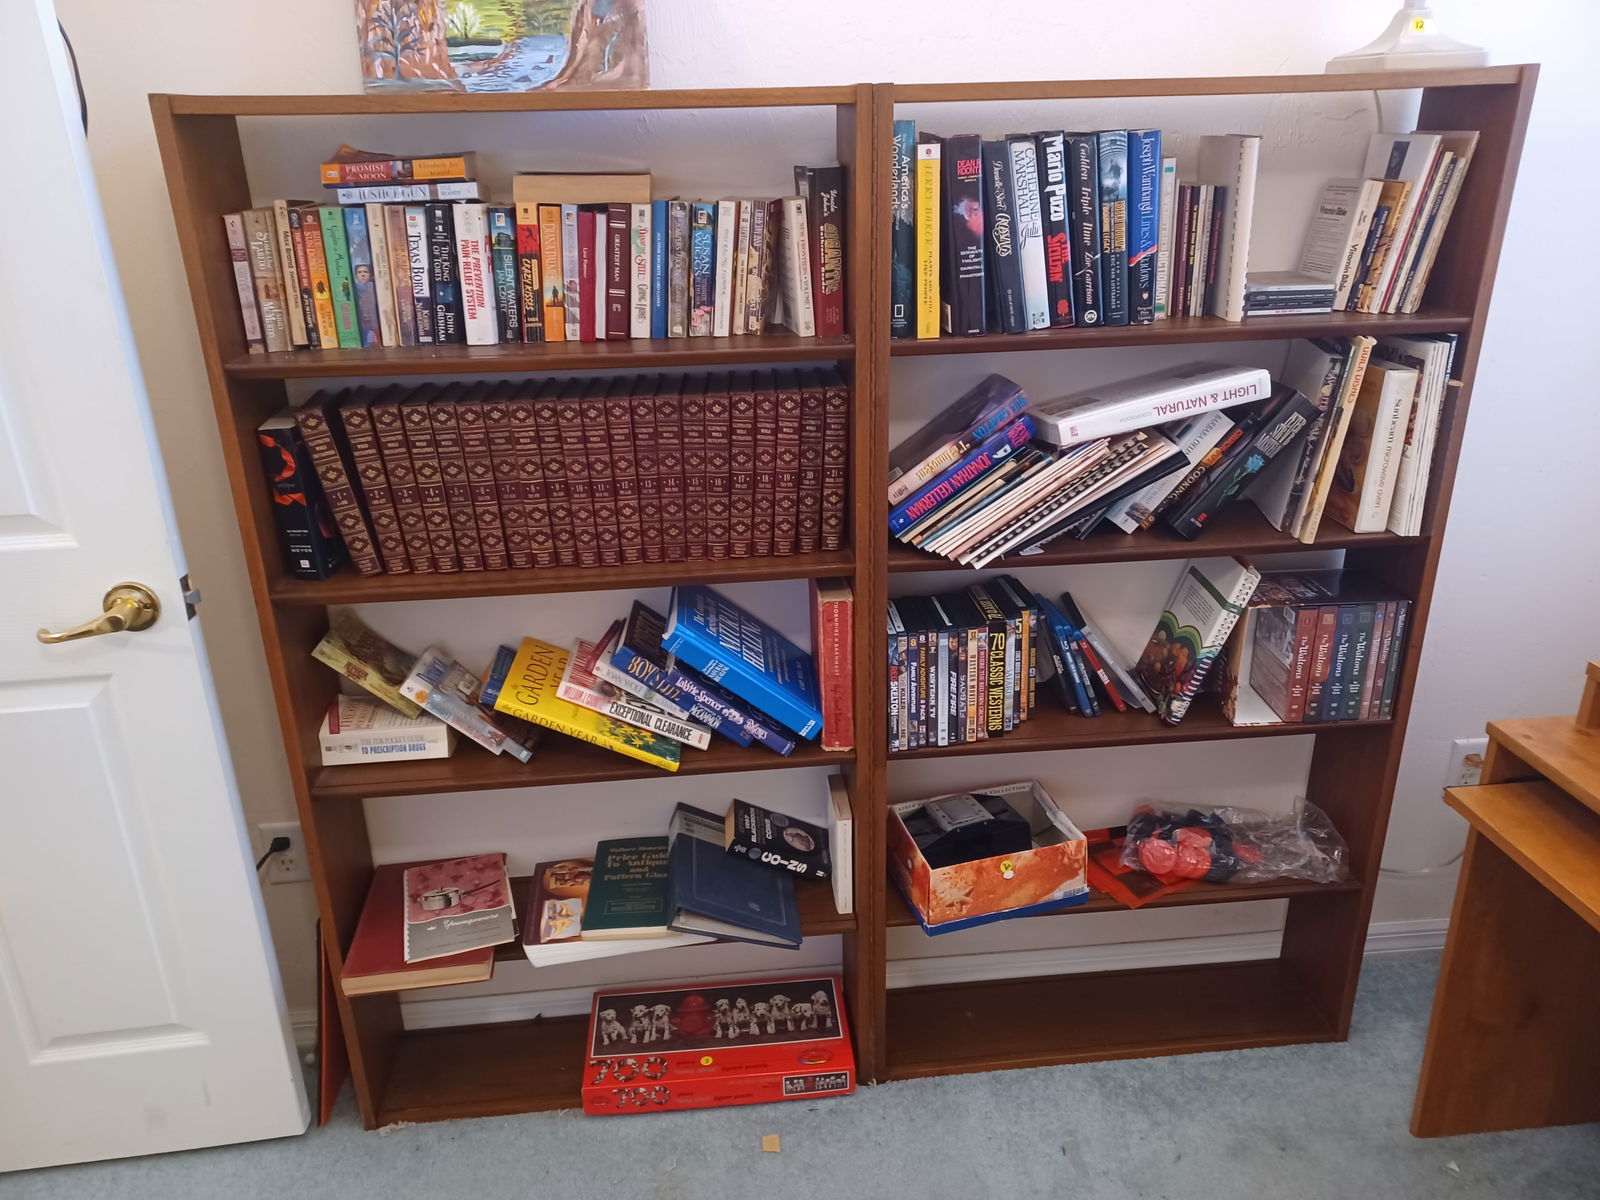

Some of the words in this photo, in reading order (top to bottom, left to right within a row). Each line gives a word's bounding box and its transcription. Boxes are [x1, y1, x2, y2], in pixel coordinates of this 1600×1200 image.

[957, 159, 976, 169] DEAN
[1042, 132, 1066, 183] Mario
[1079, 143, 1090, 179] Golden
[1139, 136, 1154, 165] Joseph
[344, 163, 385, 172] PROMISE
[358, 172, 385, 180] MOON
[891, 134, 901, 209] Wonderlands
[900, 155, 910, 208] America's
[991, 159, 1005, 189] Danielle
[924, 165, 933, 200] JERRY
[1011, 148, 1032, 221] MARSHALL
[1021, 146, 1042, 219] CATHERINE
[1138, 165, 1154, 215] Wambaugh
[819, 192, 830, 216] John's
[828, 189, 837, 212] Uncle
[1043, 183, 1066, 222] Puzo
[1079, 186, 1092, 215] Triple
[282, 230, 290, 245] Max
[542, 223, 555, 248] DIANA
[924, 207, 933, 245] BAKER
[990, 211, 1014, 257] CROSSINGS
[1082, 222, 1094, 245] Time
[1140, 215, 1152, 239] Lines
[284, 246, 294, 268] Brand
[407, 231, 423, 264] TEXAS
[431, 245, 439, 256] OF
[440, 245, 449, 260] THE
[470, 239, 478, 254] THE
[693, 231, 702, 276] WIGGS
[700, 233, 710, 274] SUSAN
[1046, 231, 1068, 283] SICILIAN
[1060, 242, 1070, 262] THE
[1102, 232, 1110, 253] LEGACY
[1140, 239, 1151, 247] &
[433, 257, 442, 281] TORTS
[441, 261, 450, 281] KING
[503, 254, 513, 285] SILENT
[521, 258, 532, 283] CRAZY
[821, 223, 842, 295] GIGANTIC
[1342, 242, 1358, 274] Vitamin
[411, 266, 425, 295] BORN
[472, 255, 484, 308] PREVENTION
[495, 269, 504, 283] JAN
[1084, 269, 1095, 304] Garrison
[1153, 251, 1170, 305] DICTIONARY
[1337, 273, 1349, 293] Bible
[466, 288, 476, 319] SYSTEM
[498, 285, 507, 312] COFFEY
[507, 289, 517, 327] WATERS
[523, 284, 533, 311] KISSES
[436, 304, 447, 341] GRISHAM
[445, 312, 455, 334] JOHN
[1356, 345, 1369, 372] QUICK
[1209, 392, 1219, 401] &
[1220, 384, 1258, 401] LIGHT
[1346, 373, 1361, 404] DISHES
[1152, 394, 1208, 417] NATURAL
[1386, 397, 1402, 443] Sunbeam
[1197, 413, 1222, 440] BARBARA
[738, 475, 745, 483] 17
[762, 475, 769, 483] 18
[806, 471, 814, 479] 20
[914, 449, 953, 481] Innocent
[948, 451, 993, 487] JONATHAN
[1377, 445, 1392, 487] microwave
[668, 478, 675, 486] 14
[714, 478, 722, 486] 16
[1168, 464, 1206, 498] COOKING
[904, 479, 954, 520] KELLERMAN
[1372, 488, 1382, 508] oven
[1016, 619, 1023, 634] 5
[1395, 613, 1405, 637] Waltons
[741, 616, 765, 673] HEALING
[990, 633, 1005, 650] 70
[1300, 636, 1308, 646] The
[1380, 637, 1390, 664] Waltons
[625, 653, 664, 687] BOY'S
[889, 665, 898, 680] RED
[988, 650, 1003, 685] CLASSIC
[1295, 644, 1308, 679] Waltons
[1314, 642, 1328, 677] Waltons
[1334, 642, 1348, 677] Waltons
[1351, 641, 1365, 676] Waltons
[516, 645, 555, 705] GARDEN
[693, 688, 726, 715] Spencer
[889, 680, 900, 715] SKELTON
[958, 674, 966, 718] FLYBOYS
[987, 686, 1003, 730] WESTERNS
[512, 707, 568, 734] GARDEN
[568, 727, 599, 744] YEAR
[608, 699, 654, 730] EXCEPTIONAL
[652, 714, 694, 744] CLEARANCE
[930, 707, 935, 718] TV
[361, 746, 368, 754] TO
[369, 743, 406, 755] PRESCRIPTION
[408, 743, 425, 751] DRUGS
[761, 851, 807, 873] COINS
[589, 1056, 668, 1085] 700
[612, 1086, 670, 1108] 700
